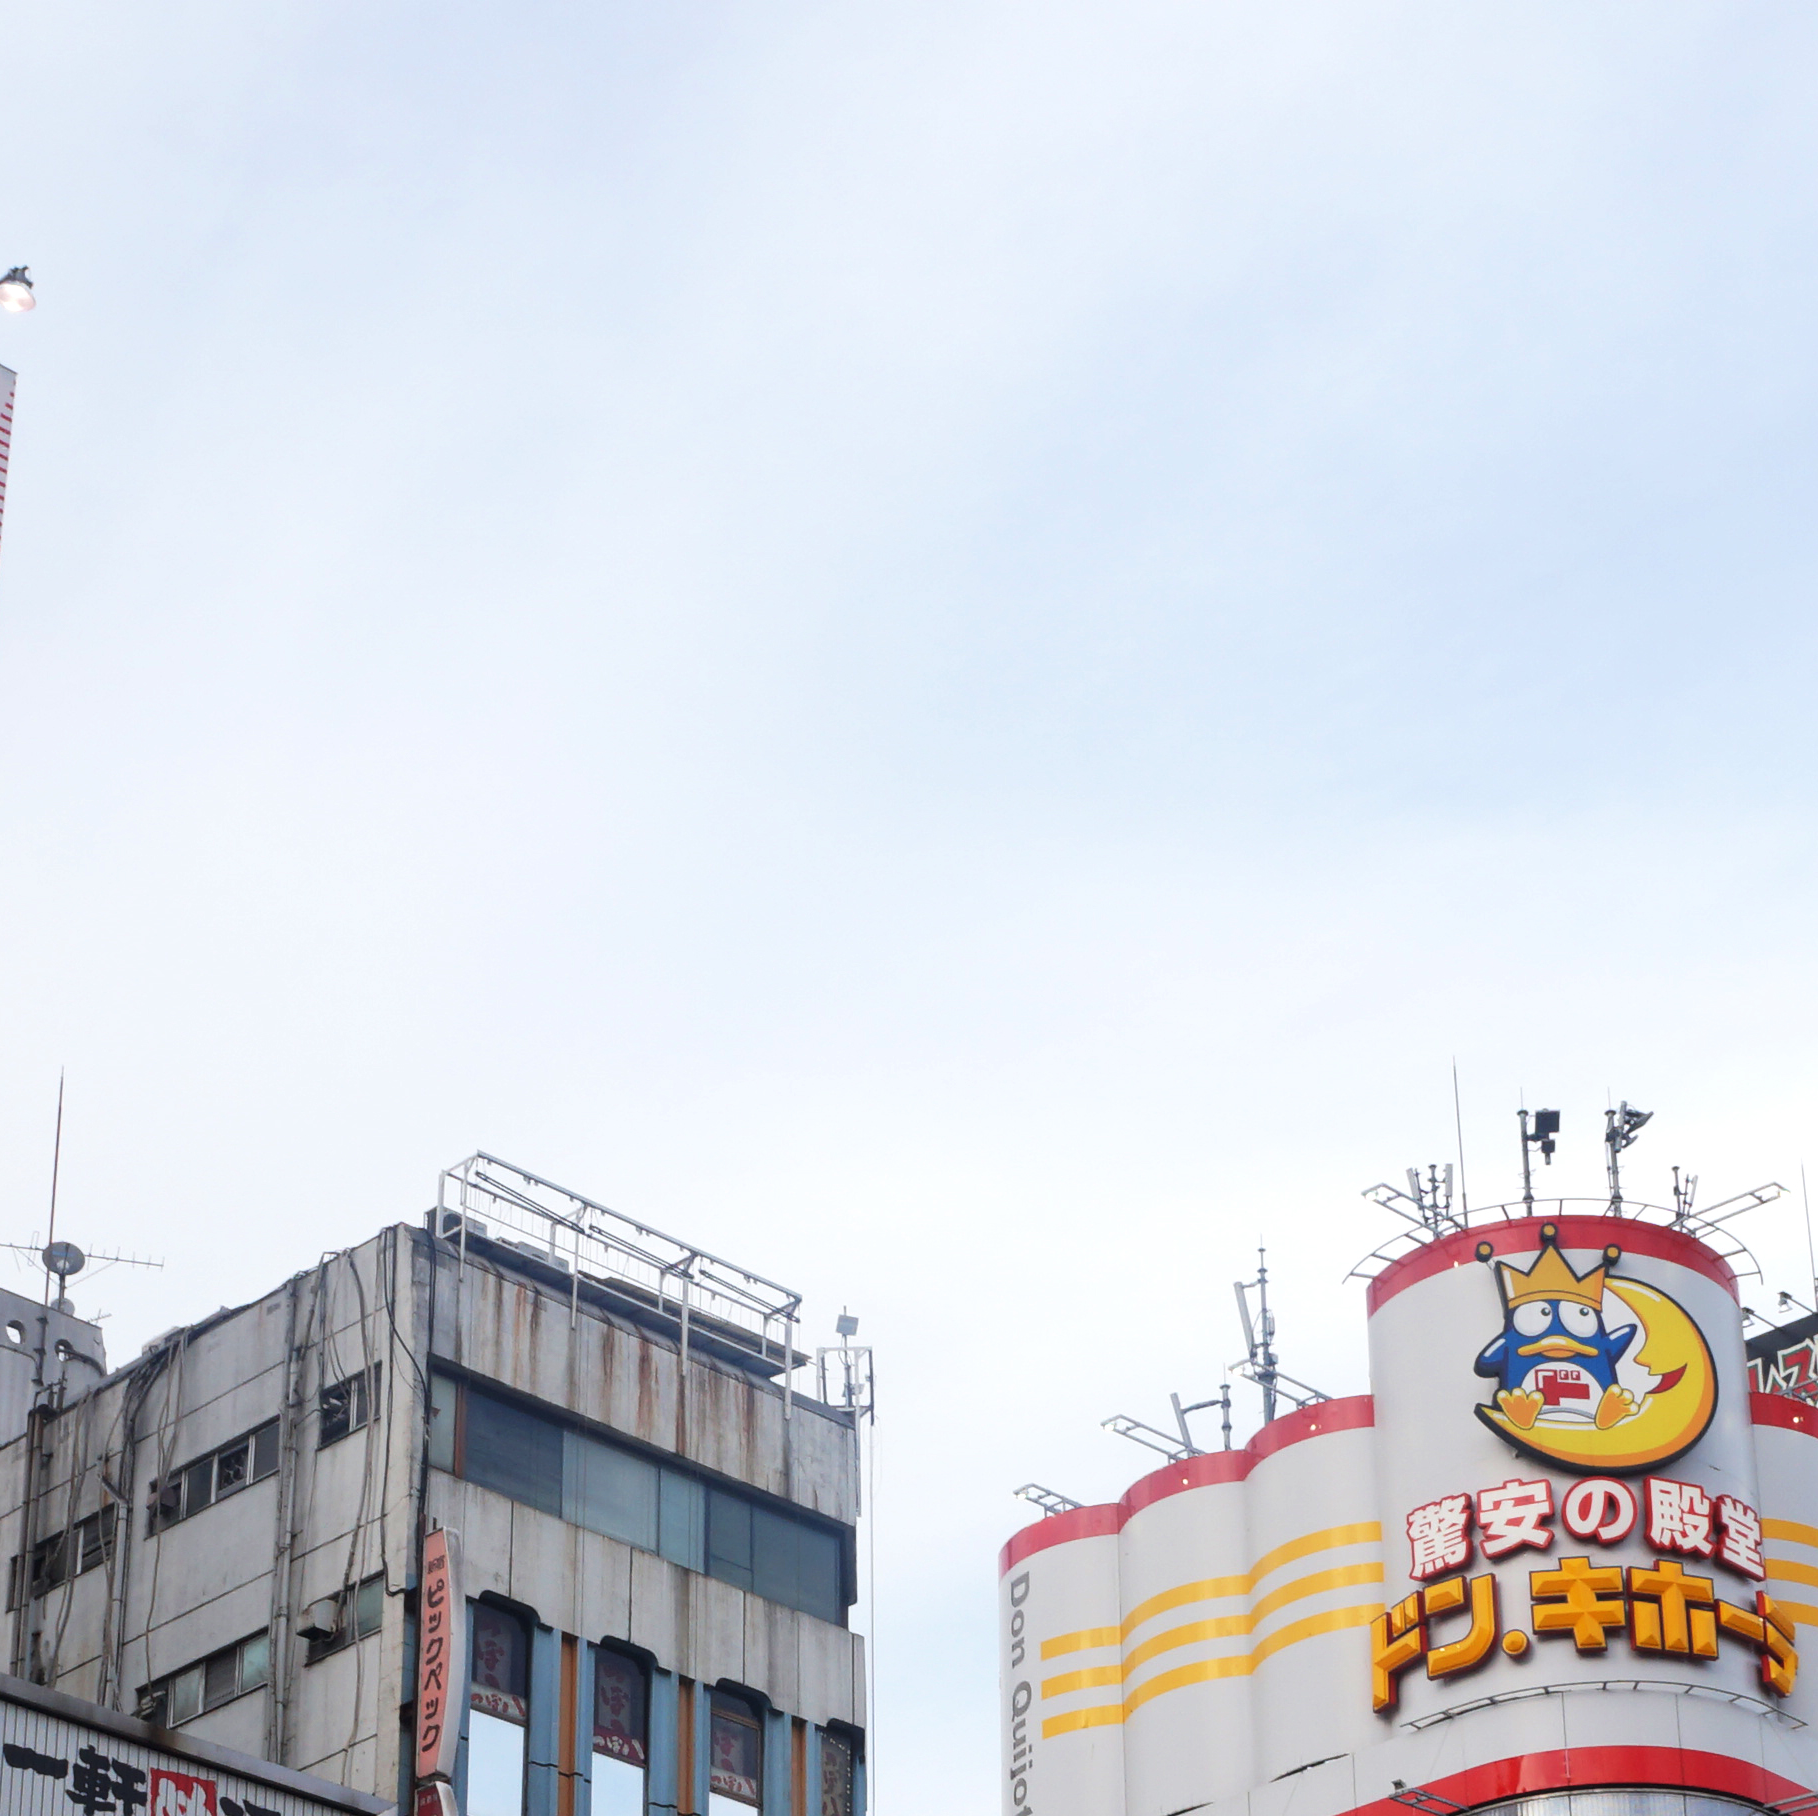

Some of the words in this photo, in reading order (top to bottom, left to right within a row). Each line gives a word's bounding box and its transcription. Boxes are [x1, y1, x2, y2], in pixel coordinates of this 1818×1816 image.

[1406, 1478, 1768, 1581] 驚安の殿堂
[1009, 1572, 1031, 1670] Don
